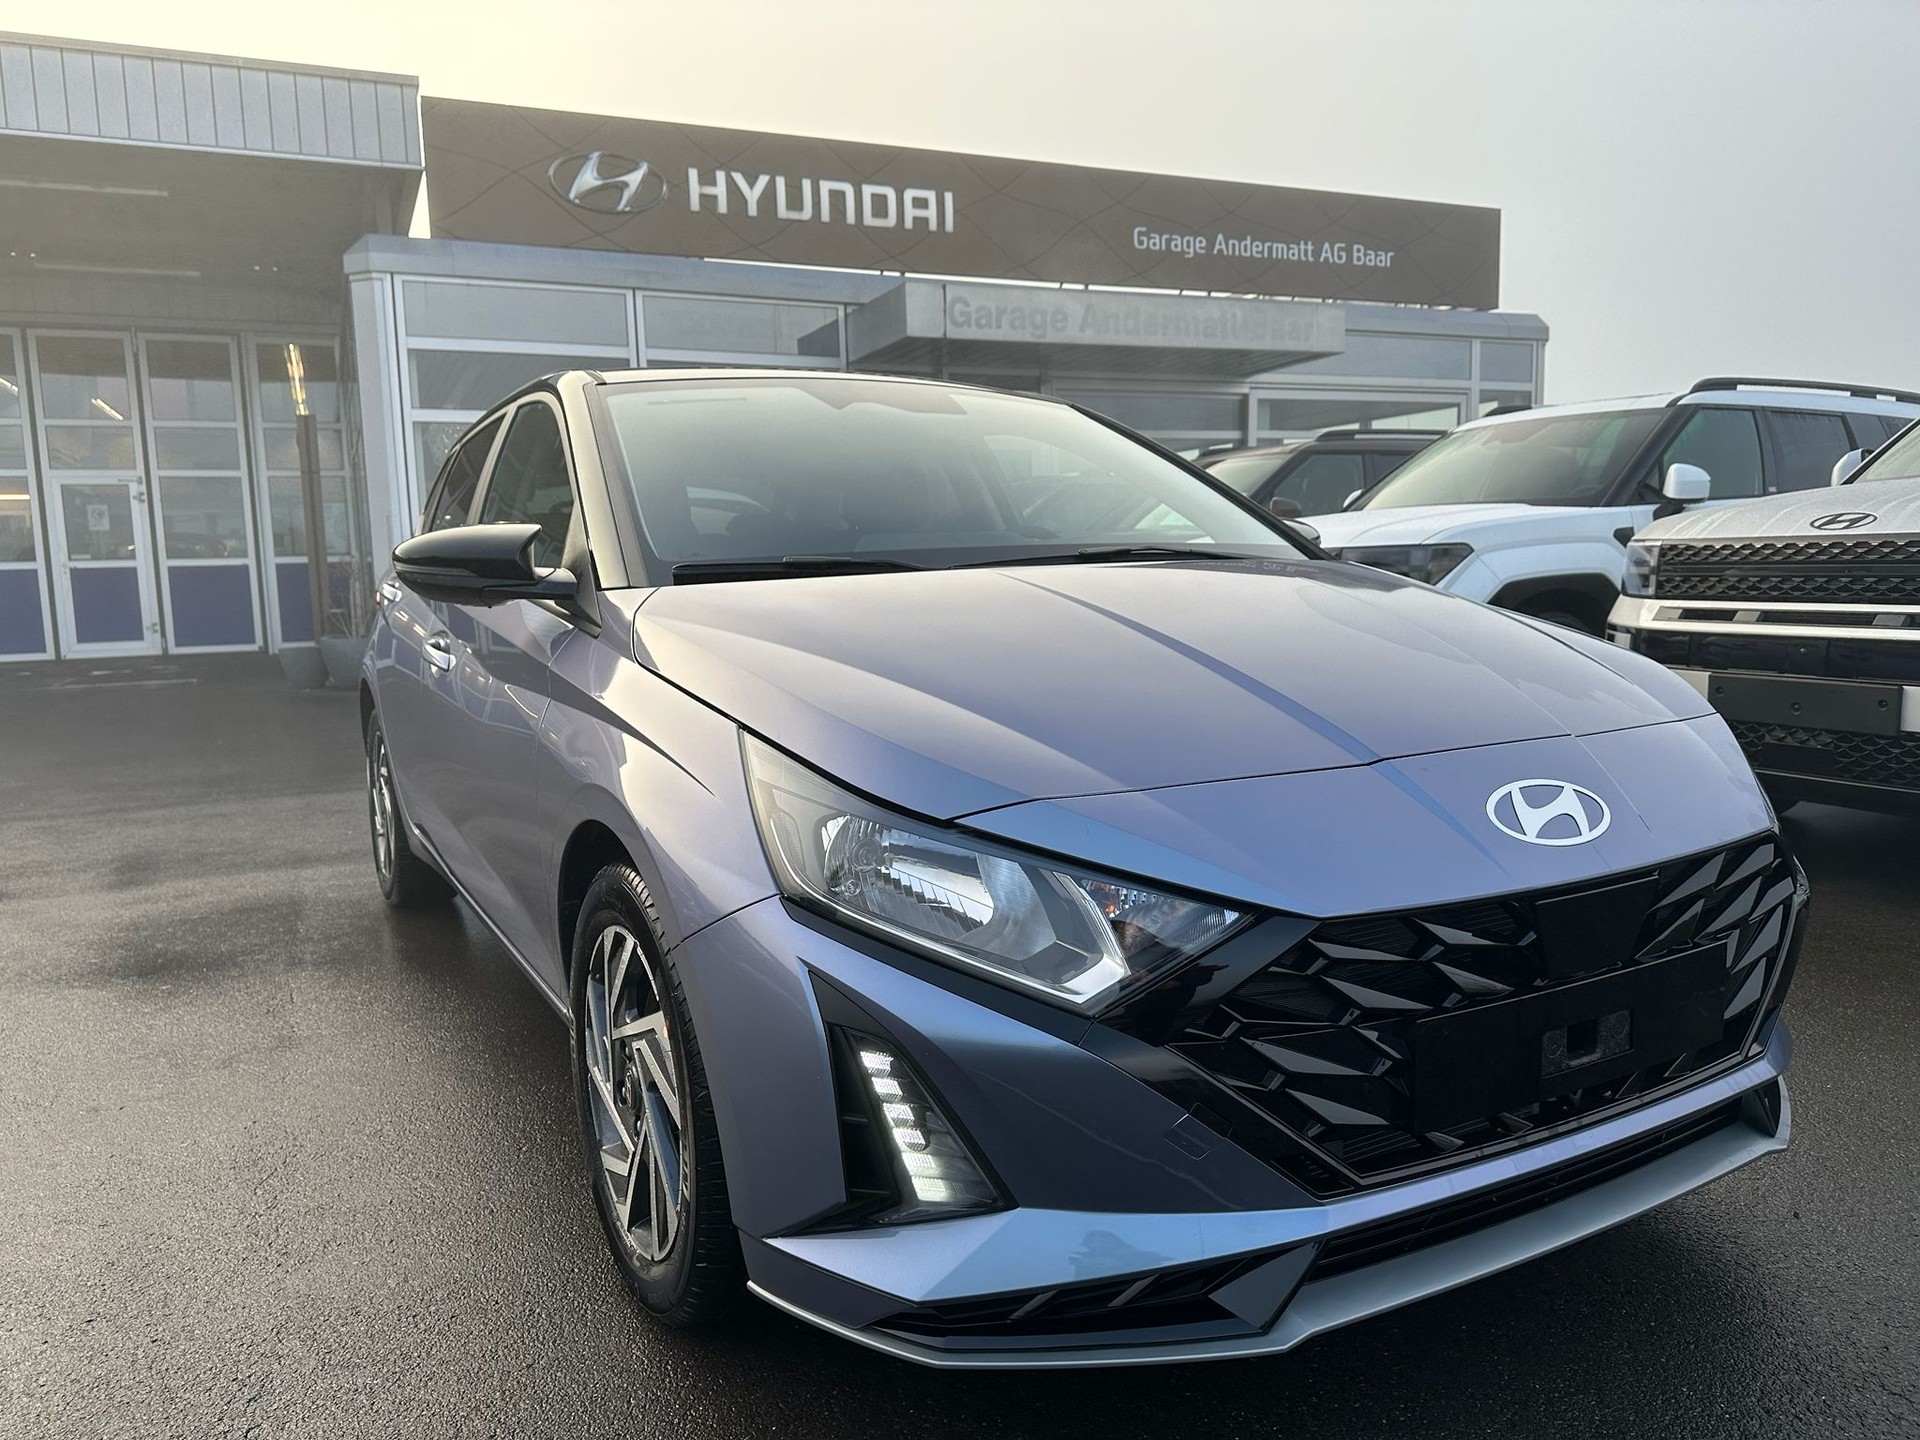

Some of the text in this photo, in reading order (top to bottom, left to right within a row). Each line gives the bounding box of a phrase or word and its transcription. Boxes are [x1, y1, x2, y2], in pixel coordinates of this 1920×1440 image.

[688, 167, 954, 233] HYUNDAI
[1133, 226, 1395, 268] Garage Andermatt AG Baar
[949, 296, 1070, 340] Garage
